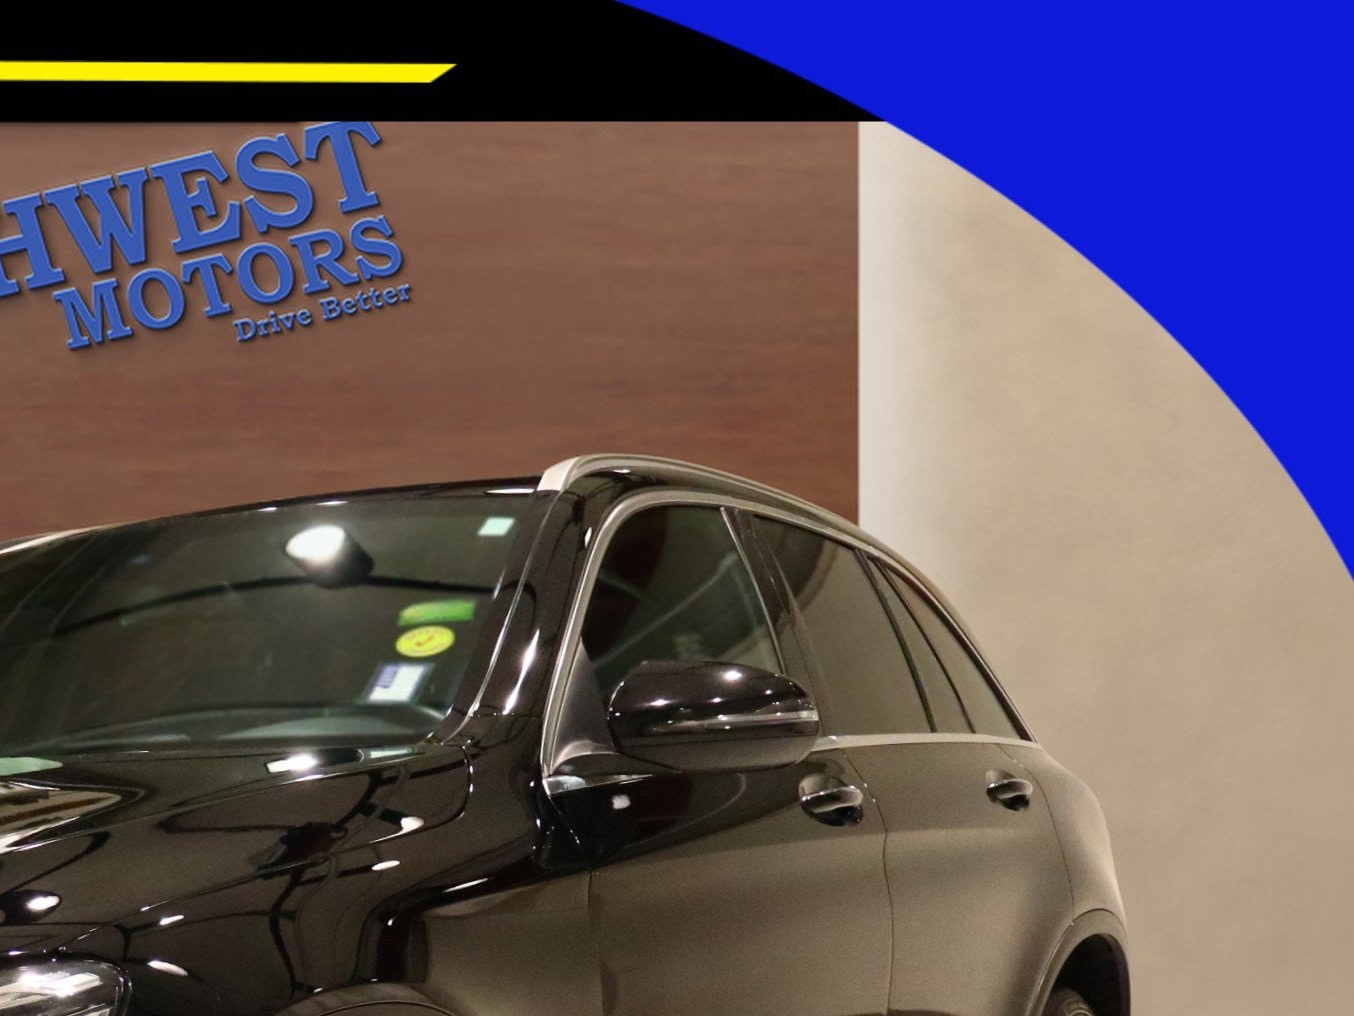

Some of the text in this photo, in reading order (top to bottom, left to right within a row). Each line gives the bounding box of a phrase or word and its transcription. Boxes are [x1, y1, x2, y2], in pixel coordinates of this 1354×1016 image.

[53, 215, 403, 349] MOTORS
[234, 284, 411, 342] Drive Better
